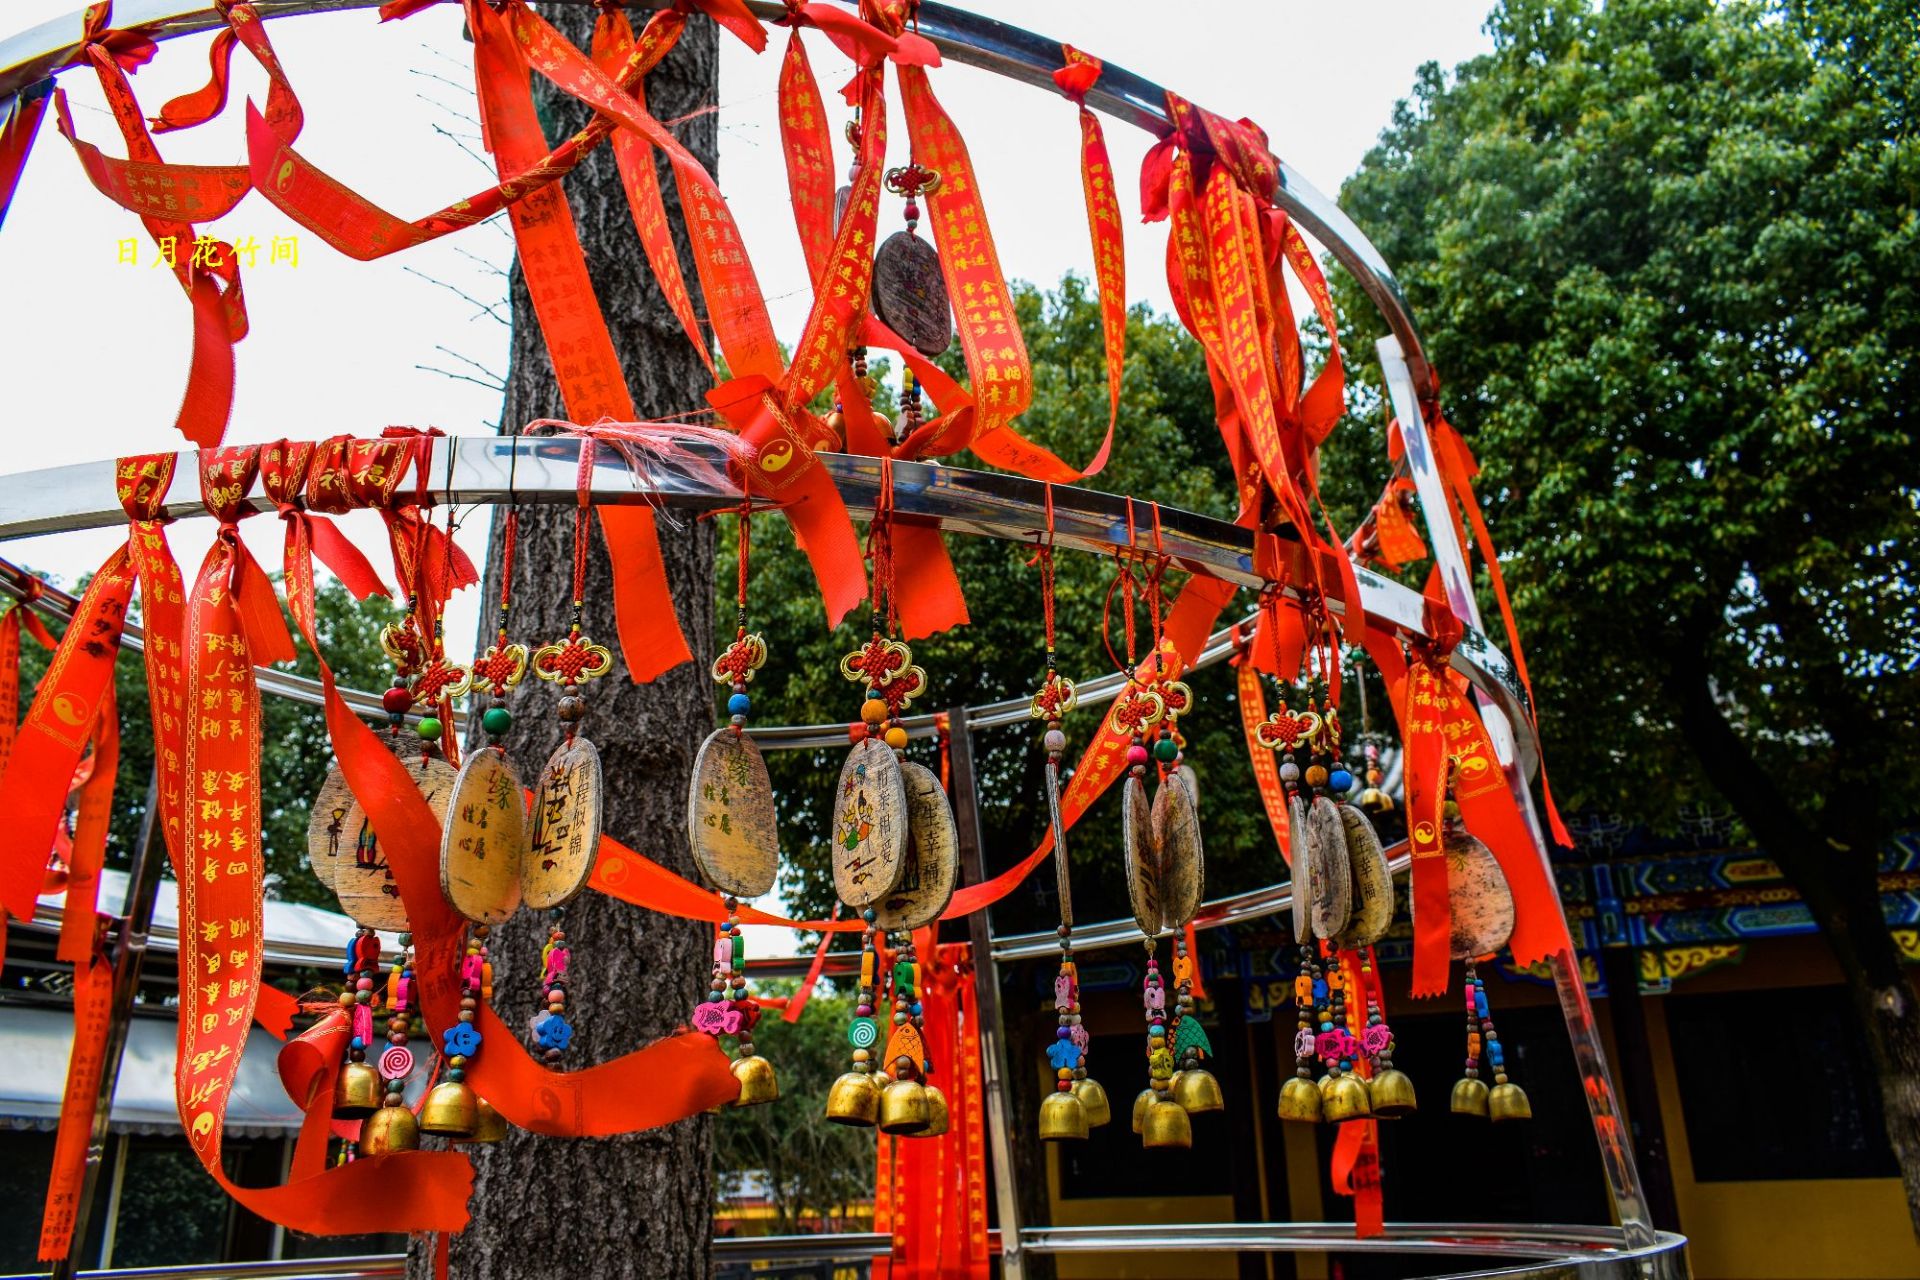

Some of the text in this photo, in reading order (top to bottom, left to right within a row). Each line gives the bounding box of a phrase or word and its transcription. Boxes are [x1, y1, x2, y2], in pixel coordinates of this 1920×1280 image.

[691, 182, 729, 266] 家庭幸福
[832, 228, 866, 299] 事业进步
[944, 210, 969, 272] 生意兴隆
[960, 203, 988, 268] 财源广进
[961, 280, 988, 338] 事业进步
[978, 278, 1008, 337] 金榜题名
[799, 313, 838, 394] 家庭幸福
[981, 347, 1005, 430] 家庭幸福
[352, 442, 397, 487] 祈福
[152, 634, 174, 734] 国泰民安
[199, 632, 227, 742] 财源广进
[224, 633, 248, 741] 生意兴隆
[197, 768, 224, 883] 身体健康
[224, 769, 251, 876] 四季平安
[568, 758, 593, 857] 前程似锦
[876, 766, 894, 868] 相亲相爱
[918, 783, 940, 884] 一生幸福
[199, 919, 224, 1035] 国泰民安
[224, 917, 251, 1027] 风调雨顺
[185, 1042, 233, 1110] 祈福
